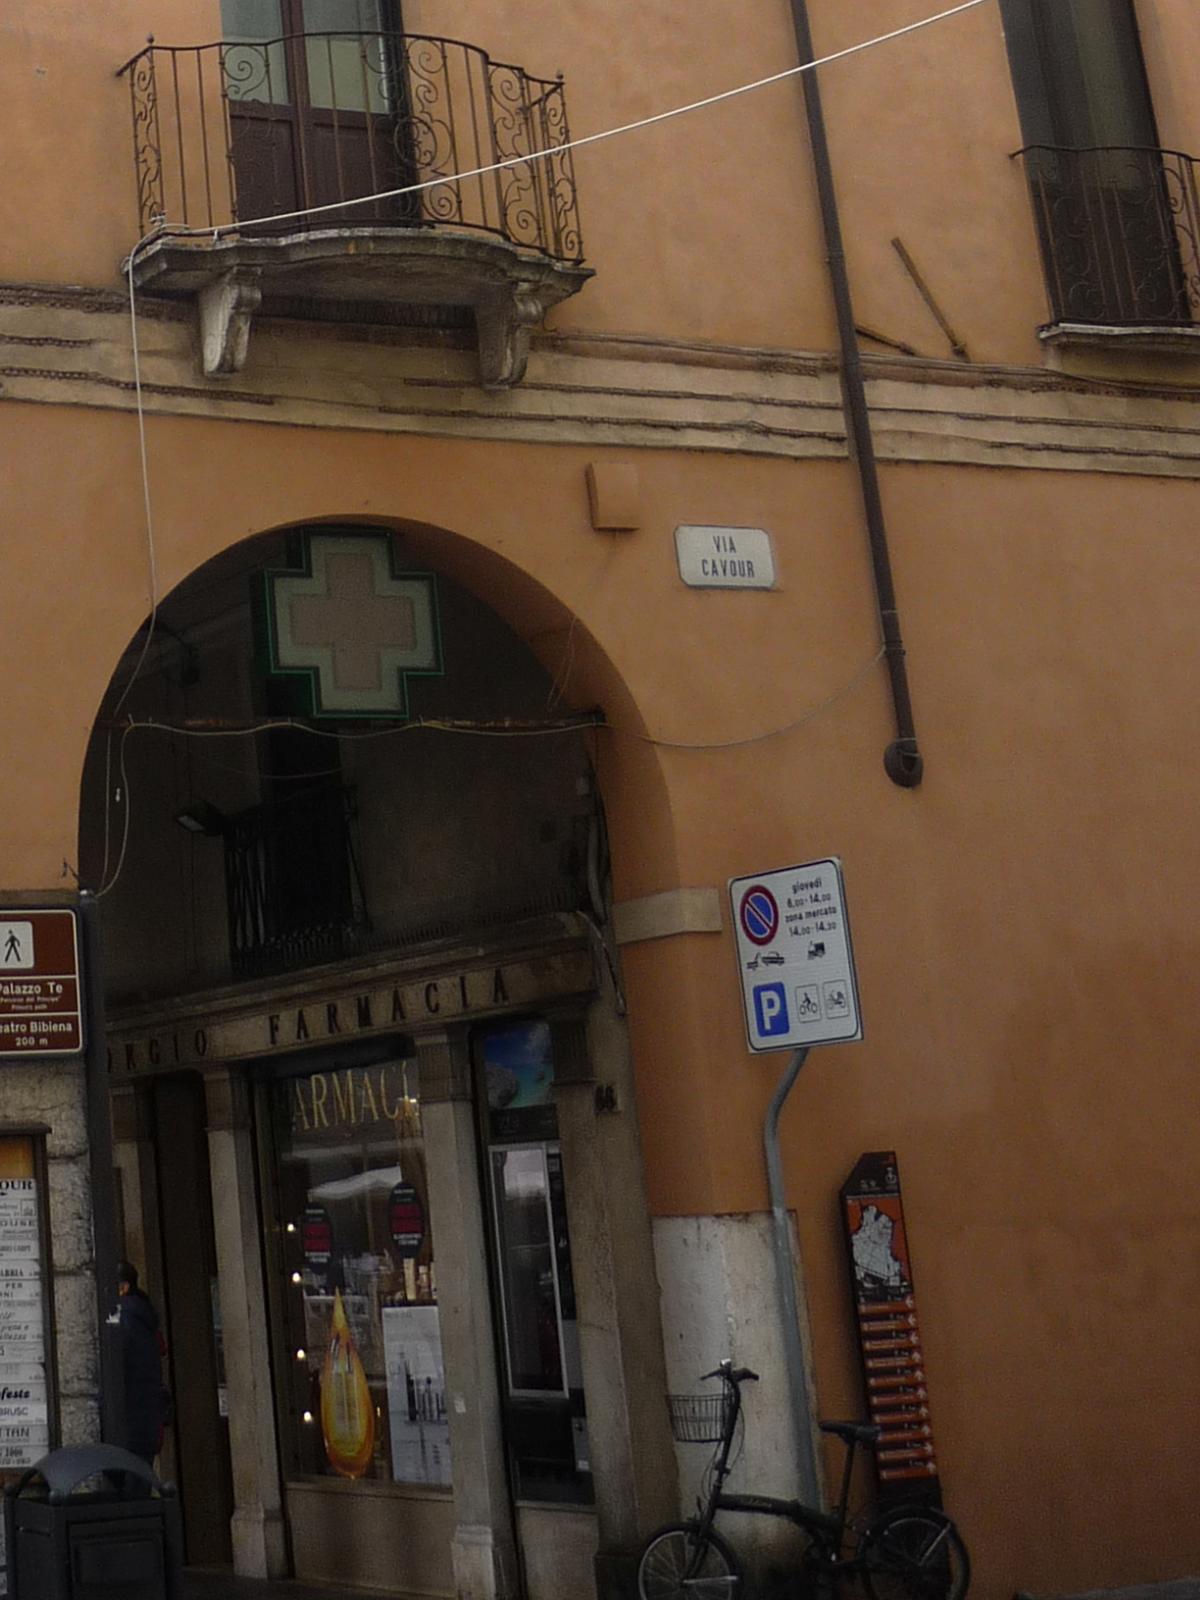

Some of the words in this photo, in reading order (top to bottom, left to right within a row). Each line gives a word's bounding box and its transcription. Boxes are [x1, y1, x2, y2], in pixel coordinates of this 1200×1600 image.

[713, 536, 736, 554] VIA
[702, 558, 754, 578] CAVOUR
[785, 912, 803, 924] zona
[805, 906, 837, 918] mercato
[47, 982, 63, 994] Te
[267, 968, 511, 1046] FARMACIA
[30, 1020, 73, 1034] Bibiena
[16, 1036, 35, 1046] 200
[39, 1036, 49, 1046] m
